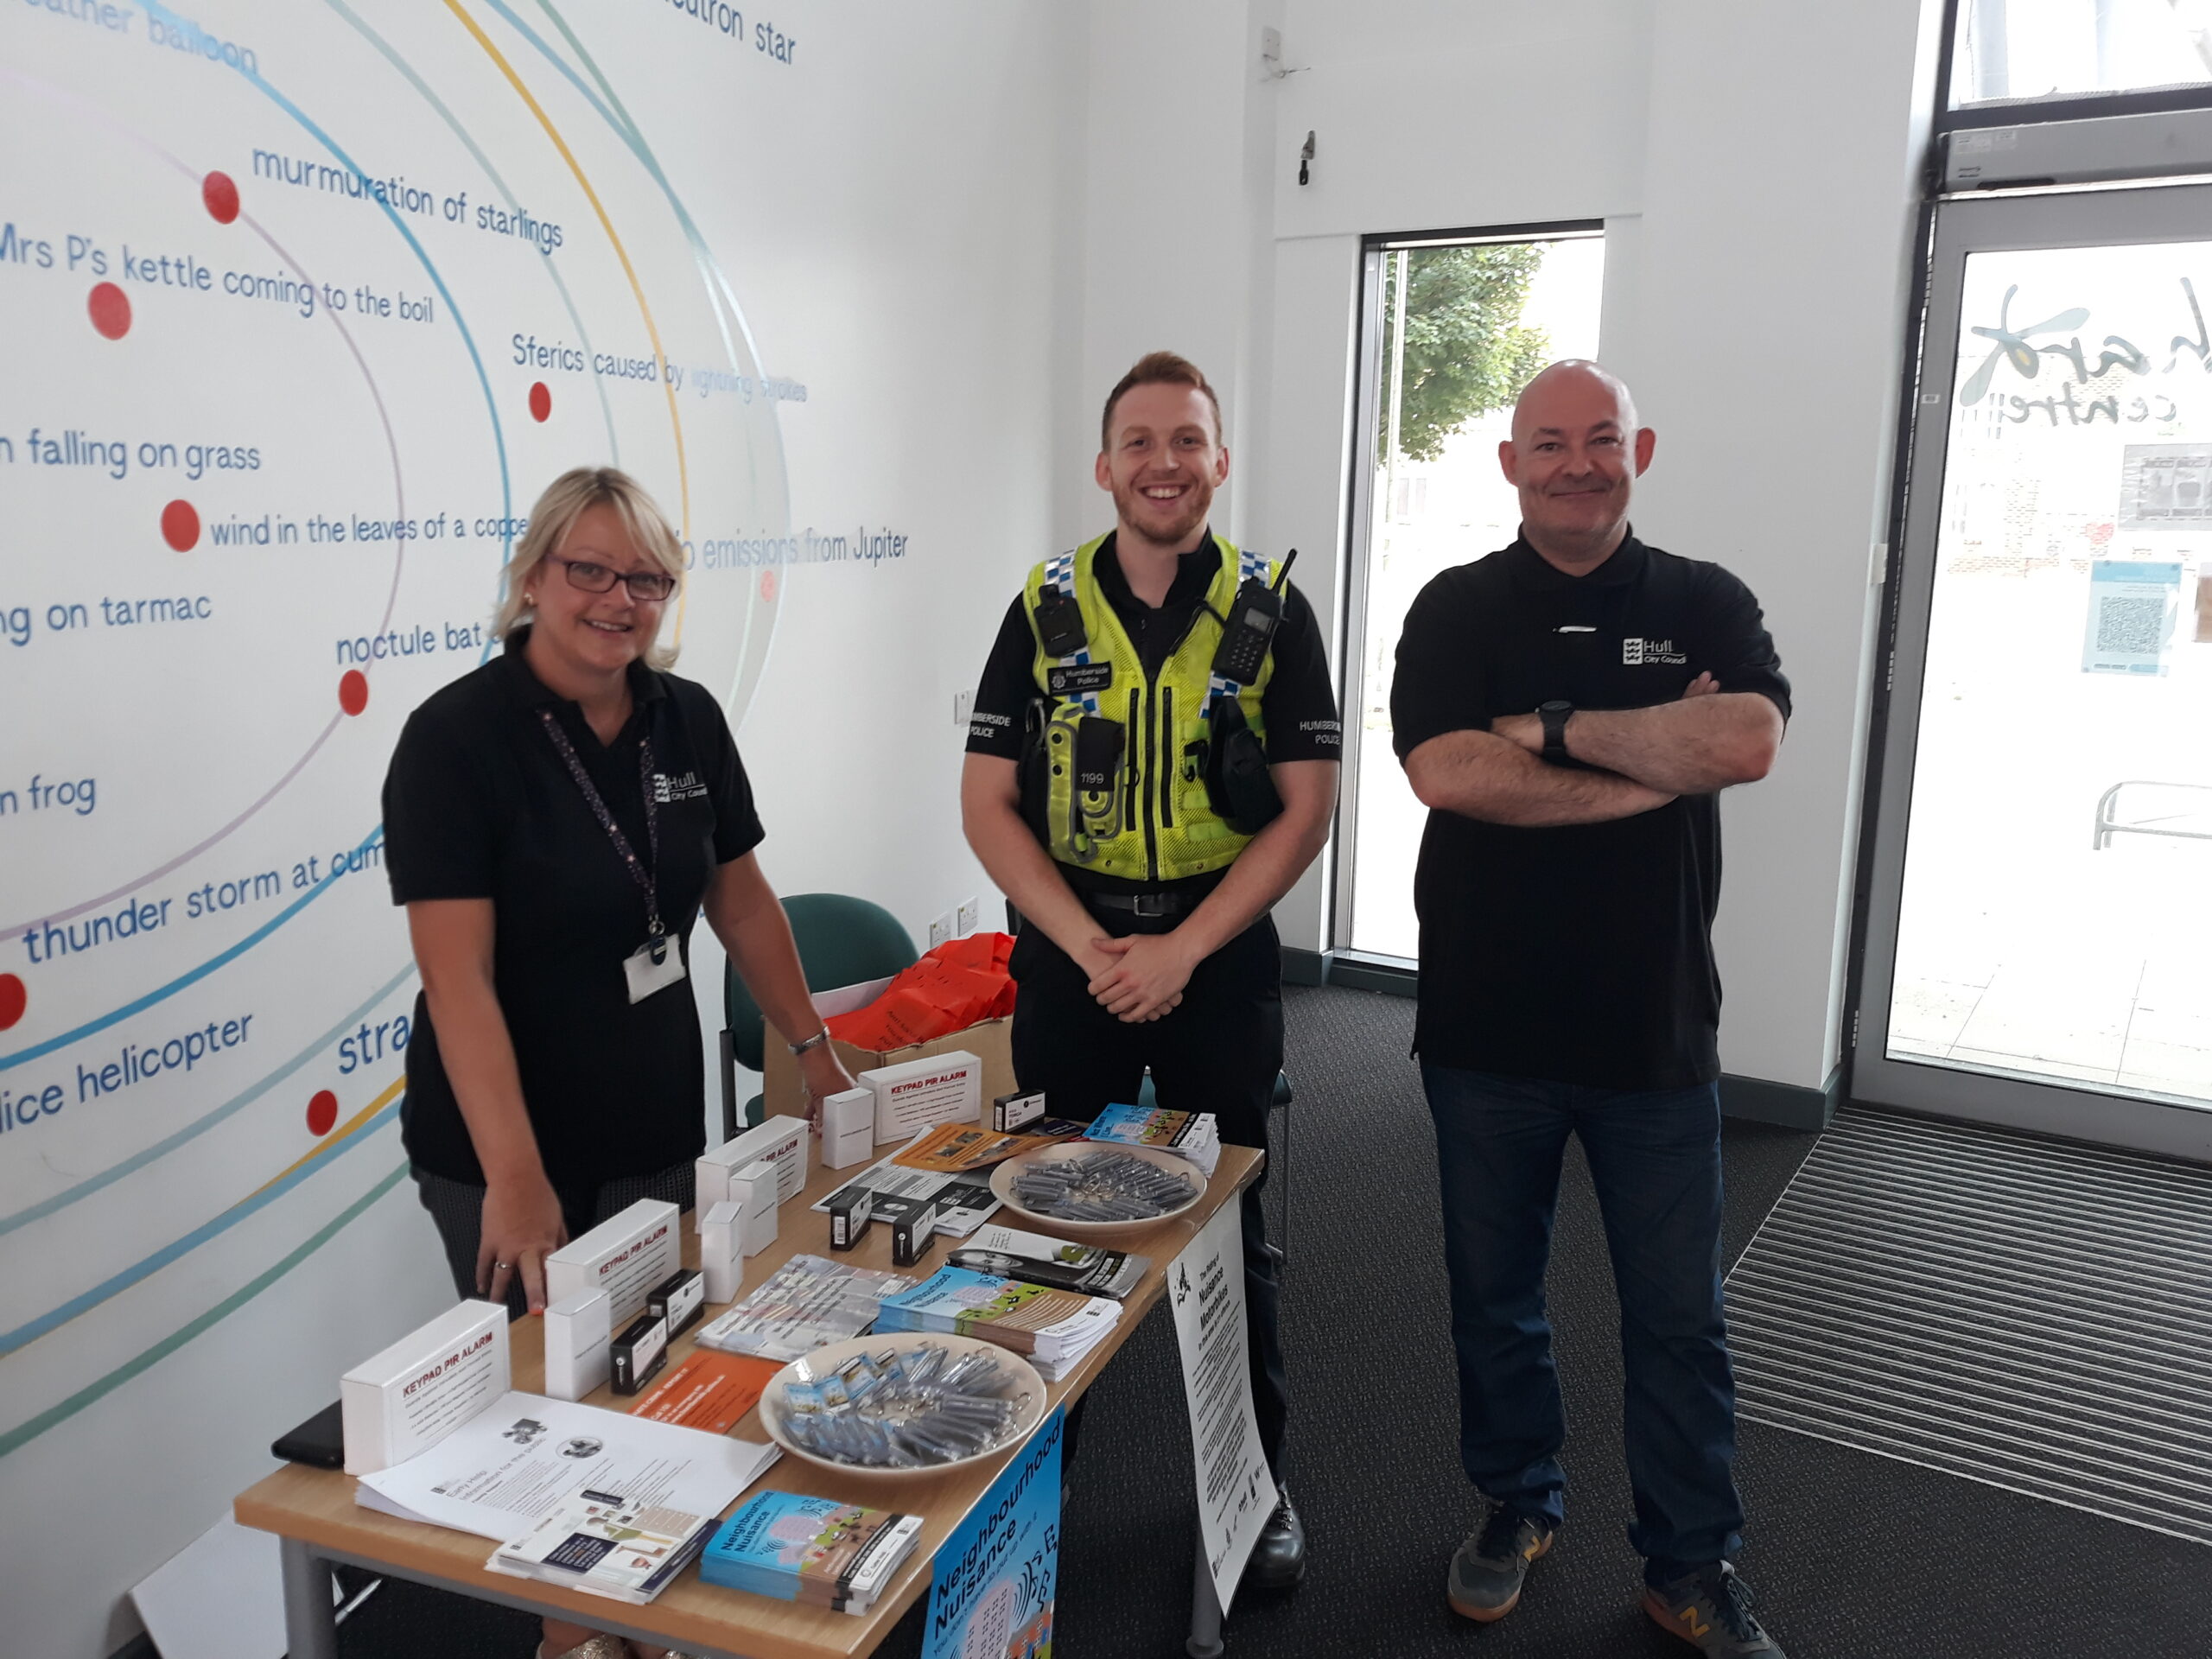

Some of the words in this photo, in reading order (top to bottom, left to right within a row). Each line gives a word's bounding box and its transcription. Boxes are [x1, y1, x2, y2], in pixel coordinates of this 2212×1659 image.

[148, 11, 257, 74] balloon
[664, 0, 743, 41] utron
[754, 22, 796, 65] star
[252, 148, 434, 216] murmuration
[443, 192, 467, 224] of
[477, 203, 563, 256] starlings
[123, 245, 213, 291] kettle
[223, 270, 315, 317] coming
[322, 282, 346, 311] to
[354, 285, 391, 317] the
[398, 291, 433, 323] boil
[512, 334, 584, 372] Sferics
[594, 353, 657, 381] caused
[663, 355, 684, 391] by
[27, 428, 128, 480] falling
[137, 438, 177, 469] on
[186, 443, 261, 480] grass
[210, 513, 270, 546] wind
[276, 513, 298, 544] in
[307, 513, 346, 543] the
[352, 512, 417, 542] leaves
[424, 512, 446, 540] of
[454, 518, 466, 538] a
[702, 527, 798, 569] emissions
[804, 526, 847, 563] from
[853, 524, 908, 568] Jupiter
[47, 604, 88, 631] on
[101, 594, 212, 626] tarmac
[335, 625, 435, 664] noctule
[444, 621, 482, 651] bat
[1643, 639, 1673, 652] Hull
[1065, 665, 1109, 677] Humberside
[1077, 677, 1100, 685] Police
[27, 773, 95, 816] frog
[666, 772, 697, 789] Hull
[1080, 772, 1104, 784] 1199
[22, 897, 172, 964] thunder
[186, 869, 281, 918] storm
[292, 855, 321, 889] at
[76, 1013, 253, 1104] helicopter
[338, 1015, 412, 1076] stra
[891, 1080, 924, 1095] KEYPAD
[925, 1077, 938, 1087] PIR
[939, 1070, 968, 1084] ALARM
[778, 1138, 798, 1157] ALARM
[598, 1251, 629, 1276] KEYPAD
[630, 1242, 643, 1256] PIR
[643, 1224, 668, 1249] ALARM
[1198, 1266, 1224, 1306] Nuisance
[1199, 1283, 1229, 1332] Motorbikes
[402, 1365, 442, 1398] KEYPAD
[443, 1353, 460, 1371] PIR
[461, 1331, 493, 1361] ALARM
[721, 1491, 774, 1551] Neighbourhood
[734, 1510, 770, 1553] Nuisance
[937, 1415, 1061, 1609] Neighbourhood
[935, 1519, 1016, 1641] Nuisance
